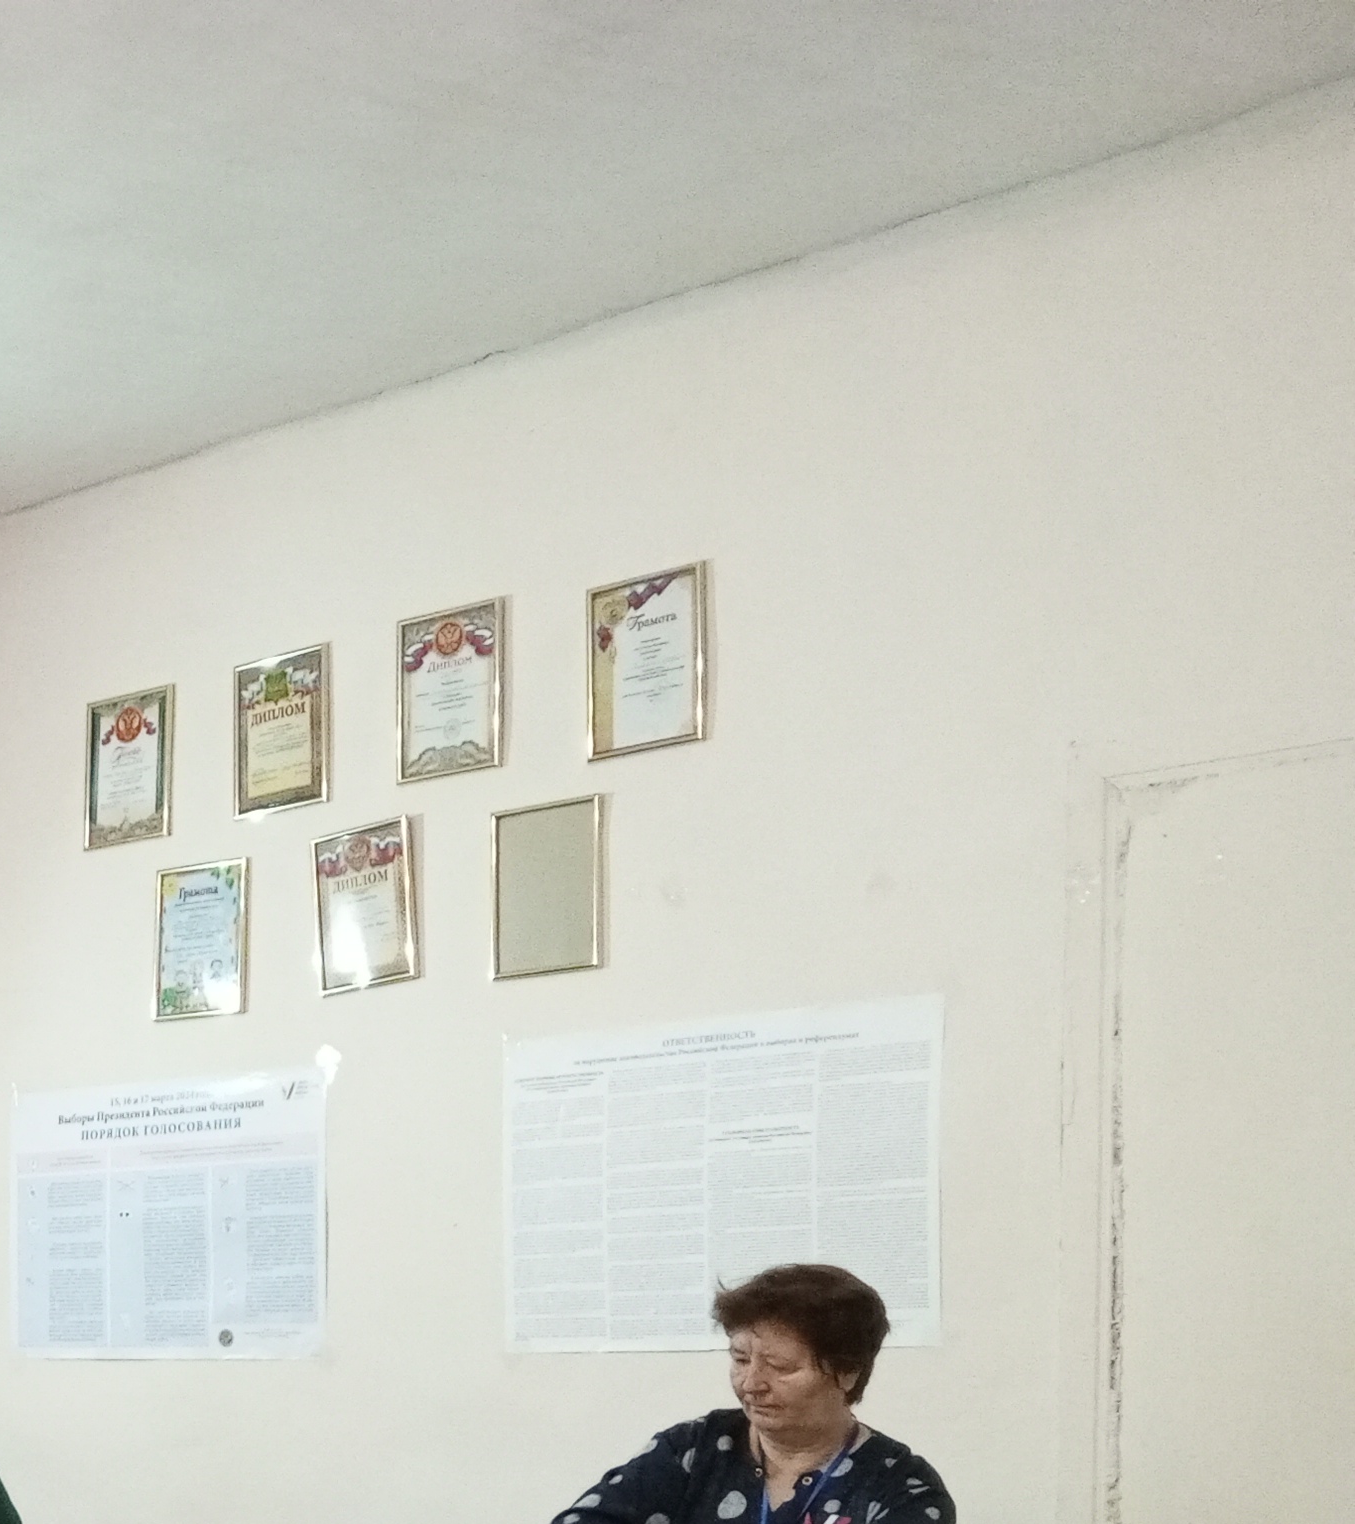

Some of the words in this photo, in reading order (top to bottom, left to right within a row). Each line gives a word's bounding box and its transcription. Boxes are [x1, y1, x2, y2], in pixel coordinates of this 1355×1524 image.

[627, 613, 678, 631] Грамота
[427, 656, 473, 673] Диплом
[250, 701, 306, 728] ДИПЛОМ
[333, 869, 388, 894] ДИПЛОМ
[661, 1029, 756, 1048] ОТВЕТСТВЕННОСТЬ
[58, 1113, 95, 1126] Выборы
[97, 1109, 151, 1124] Президента
[210, 1099, 265, 1113] Федерации
[81, 1125, 140, 1141] ПОРЯДОК
[143, 1117, 242, 1137] ГОЛОСОВАНИЯ
